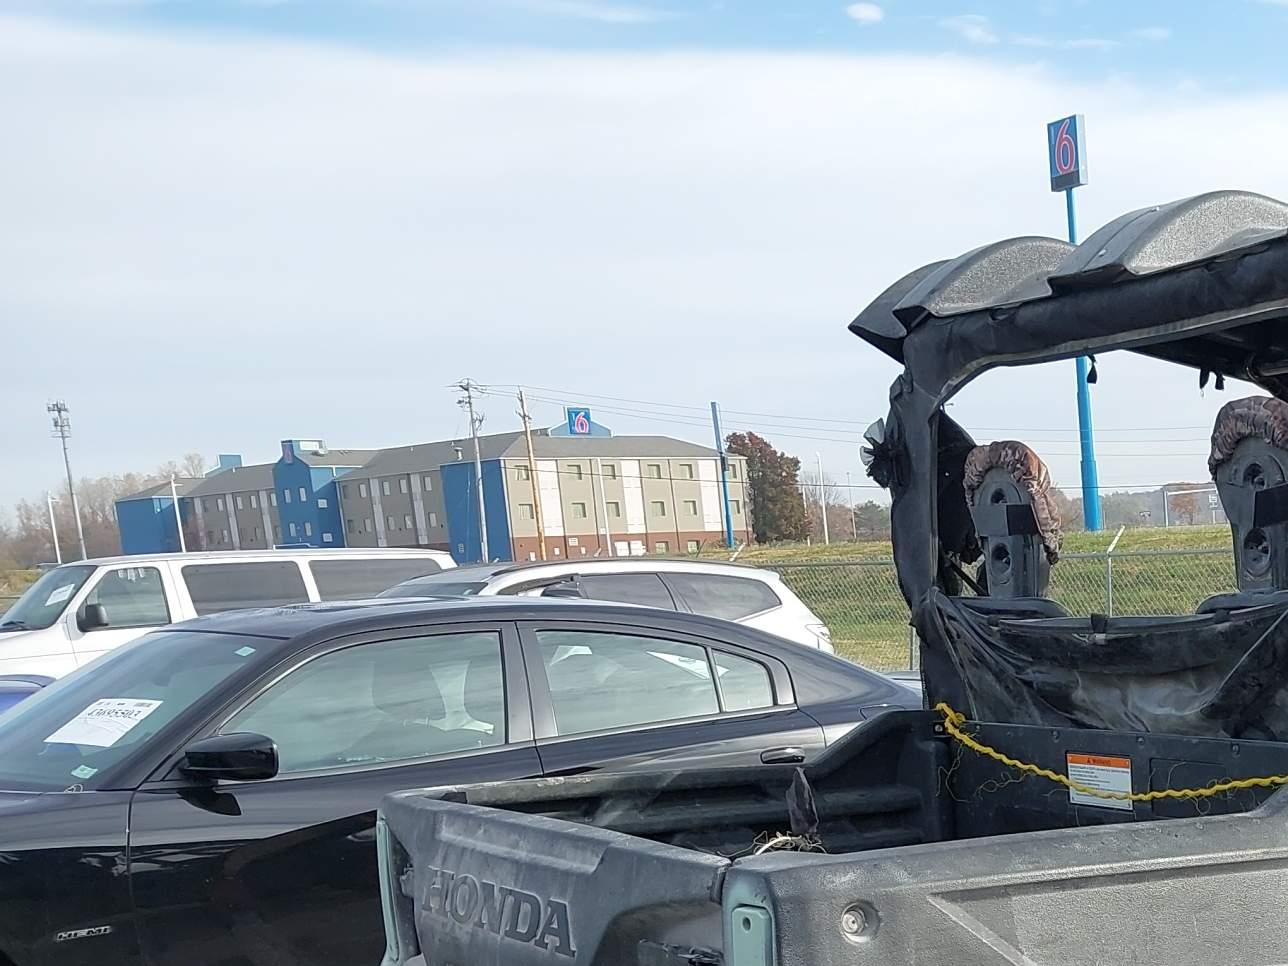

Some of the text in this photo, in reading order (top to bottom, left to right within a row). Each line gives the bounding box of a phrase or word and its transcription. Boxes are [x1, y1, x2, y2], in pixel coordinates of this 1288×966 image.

[1055, 118, 1076, 175] 6
[574, 411, 590, 434] 6
[422, 865, 577, 958] HONDA
[56, 925, 112, 942] HEMI
